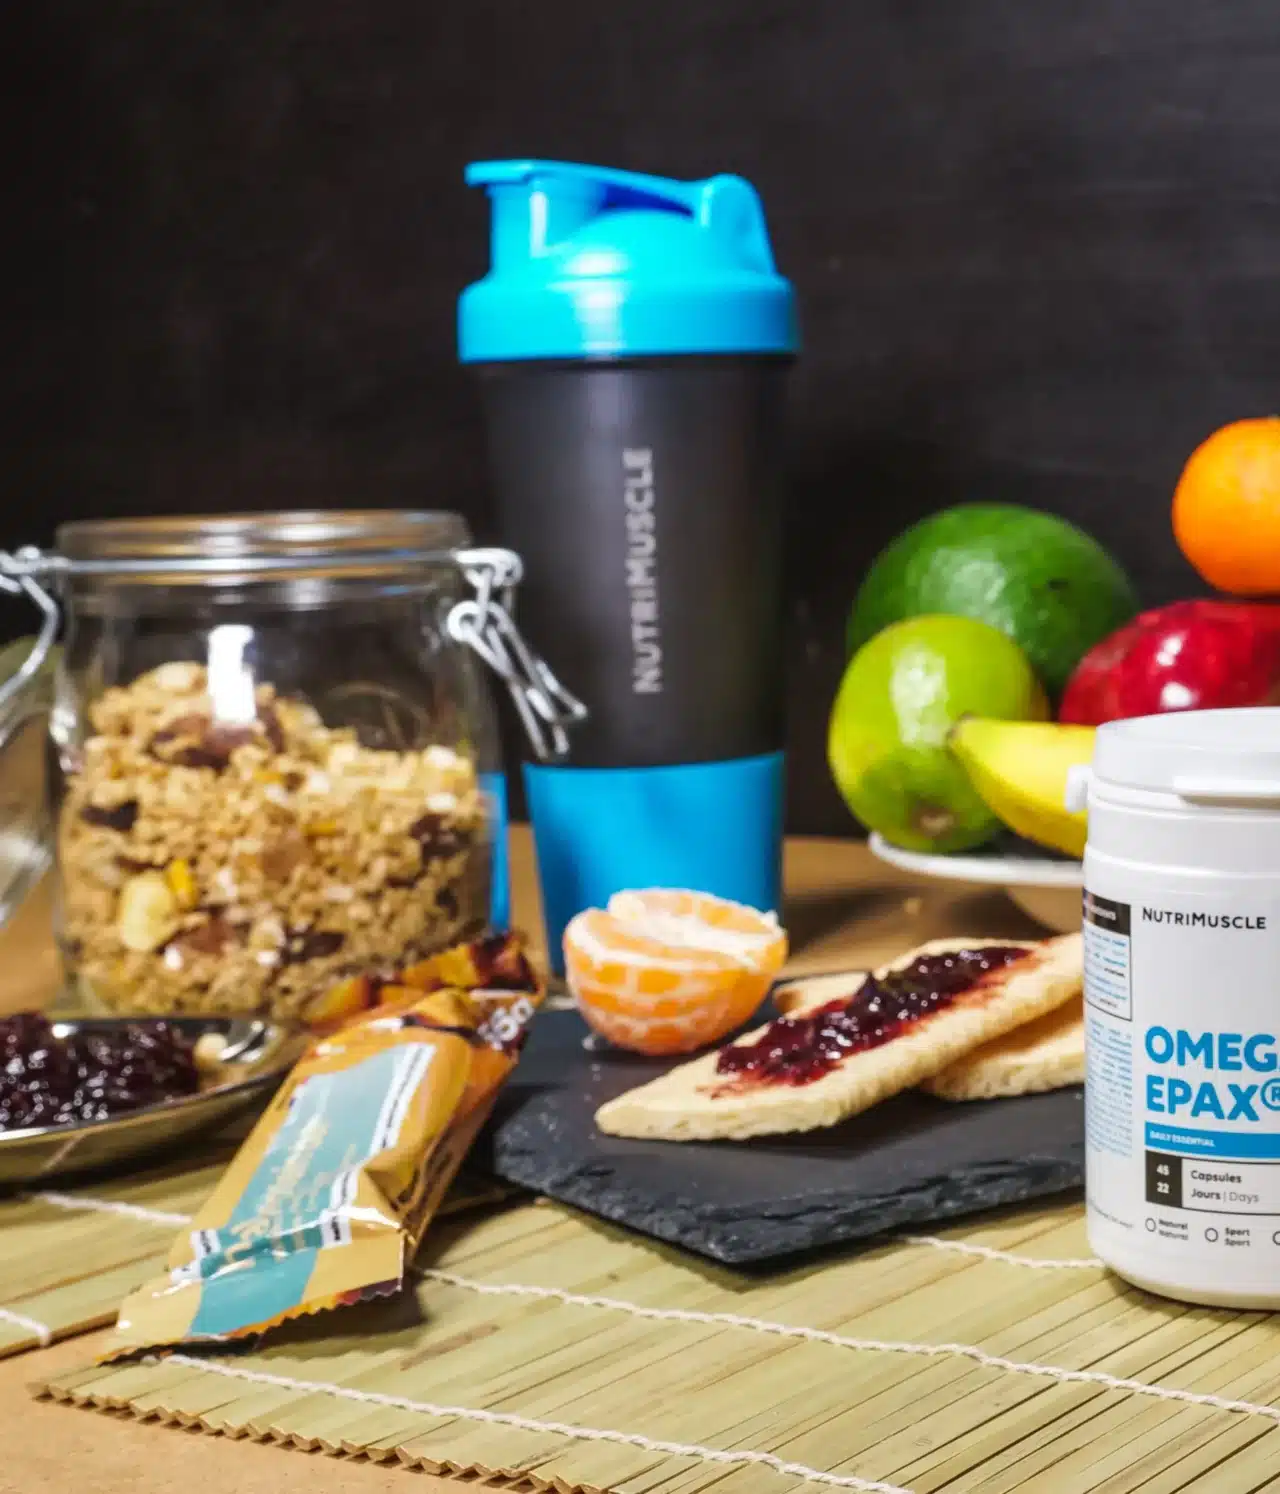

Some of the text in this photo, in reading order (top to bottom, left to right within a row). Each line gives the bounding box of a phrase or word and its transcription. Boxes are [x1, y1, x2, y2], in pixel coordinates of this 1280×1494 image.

[622, 447, 664, 694] NUTRIMUSCLE
[1142, 906, 1267, 930] NUTRIMUSCLE
[1190, 1169, 1243, 1183] Capsules
[1190, 1187, 1221, 1201] Jours
[1228, 1191, 1260, 1204] Days
[1225, 1227, 1251, 1238] Sport
[1225, 1237, 1251, 1248] Sport
